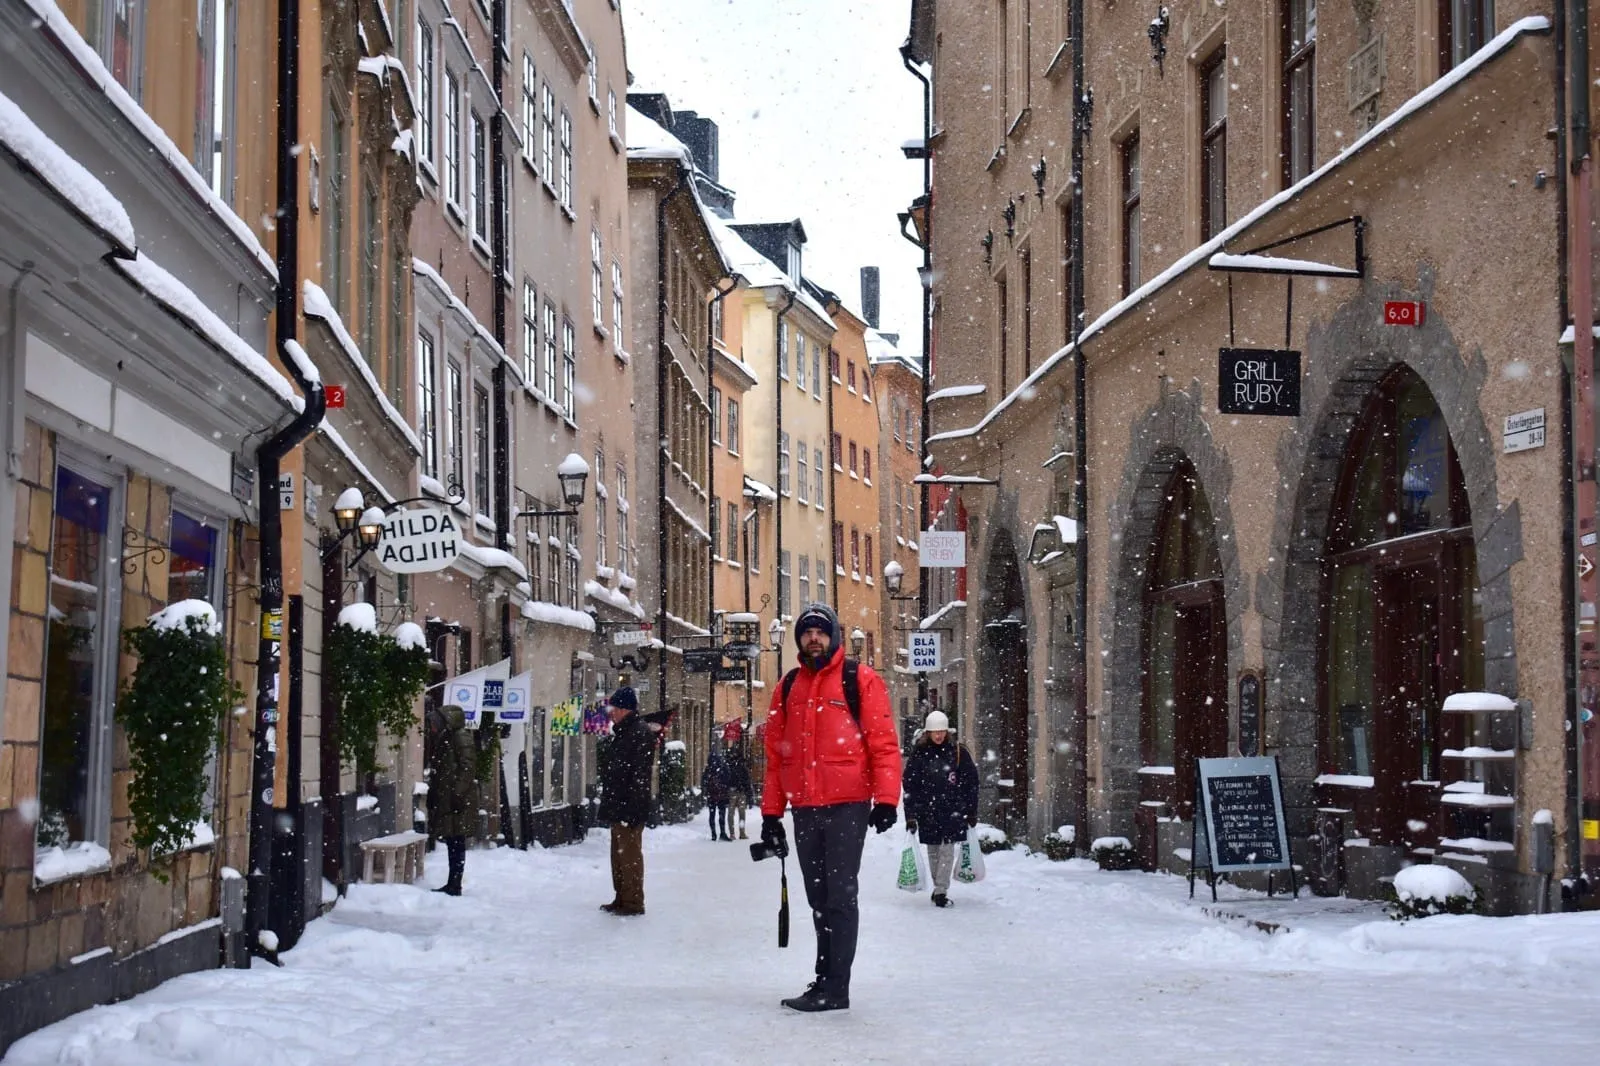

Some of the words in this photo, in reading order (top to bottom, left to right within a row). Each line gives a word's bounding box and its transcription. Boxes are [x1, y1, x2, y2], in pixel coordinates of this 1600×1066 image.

[1388, 307, 1410, 320] 6,0
[1234, 360, 1284, 382] GRILL
[1234, 382, 1284, 405] RUBY
[381, 514, 456, 540] HILDA
[924, 535, 961, 548] BISTRO
[929, 548, 957, 561] RUBY
[913, 634, 936, 646] BLÅ
[913, 647, 936, 656] GUN
[913, 658, 936, 667] GAN
